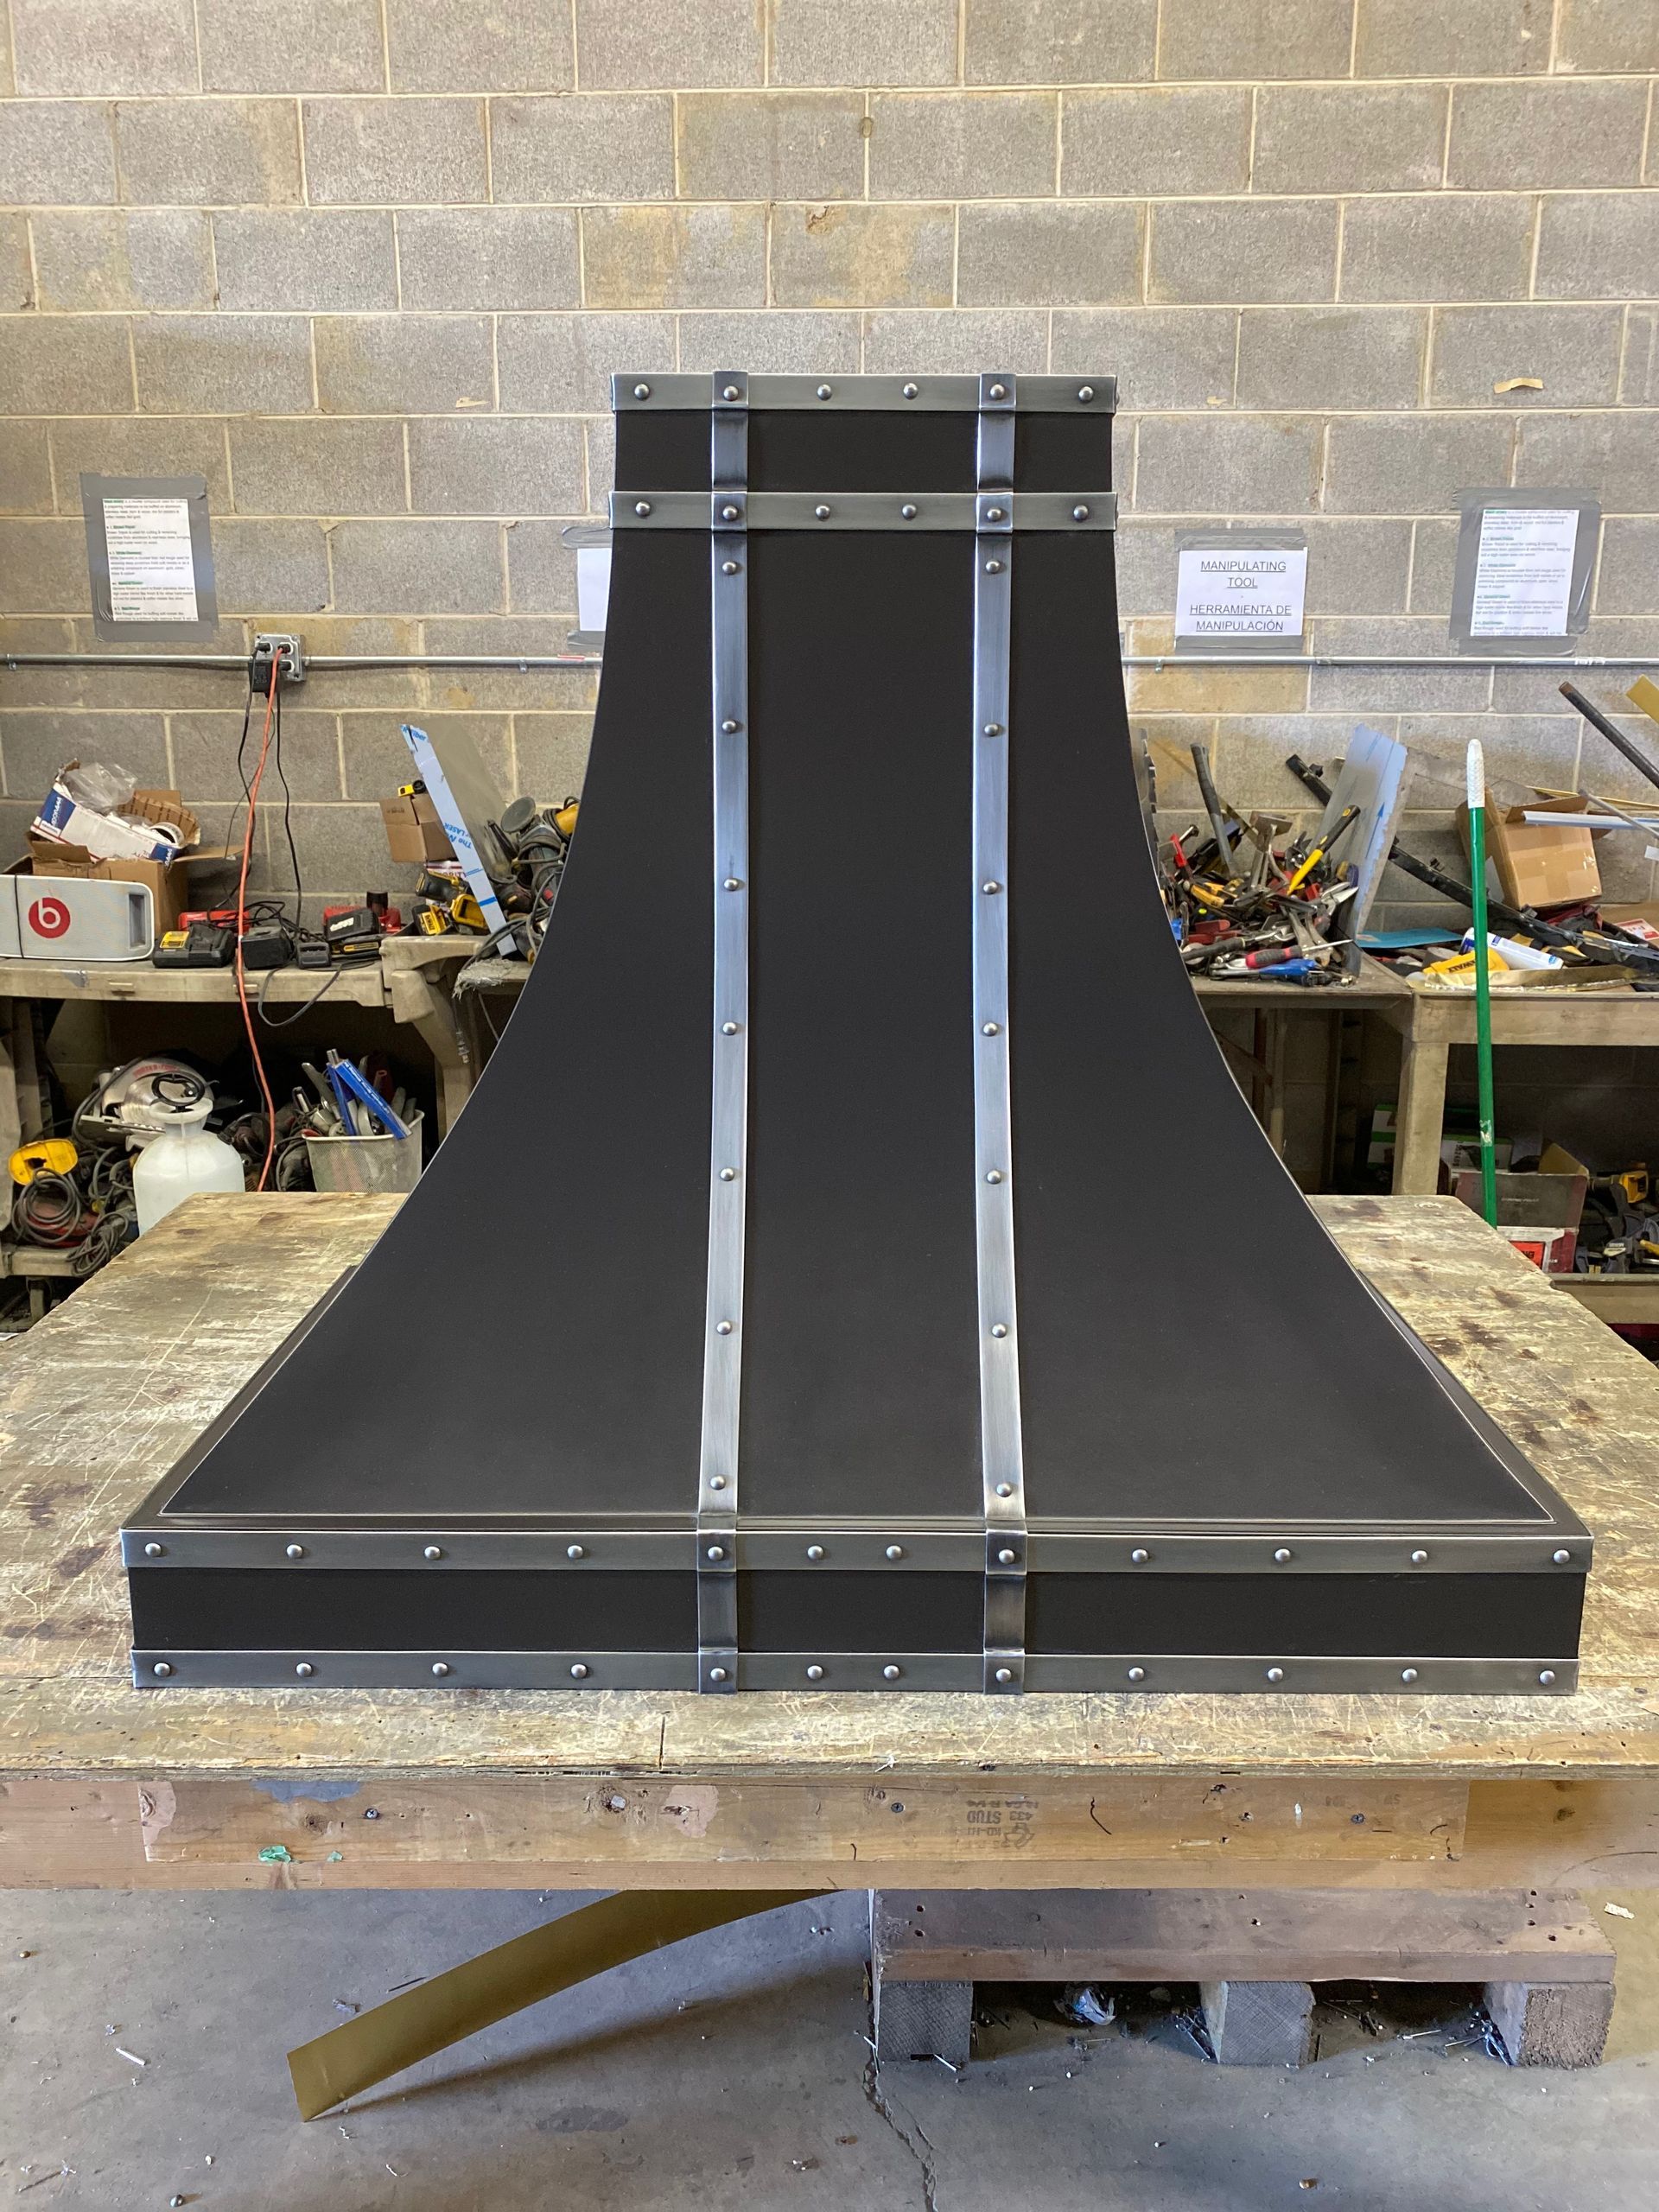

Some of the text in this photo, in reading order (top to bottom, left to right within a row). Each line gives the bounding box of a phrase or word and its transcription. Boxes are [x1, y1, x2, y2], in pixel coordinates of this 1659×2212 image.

[1200, 561, 1287, 571] MANIPULATING
[1228, 577, 1258, 588] TOOL
[1190, 605, 1293, 614] HERRAMIENTA DE
[1196, 620, 1284, 631] MANIPULACIÓN
[967, 1810, 1001, 1824] STUD
